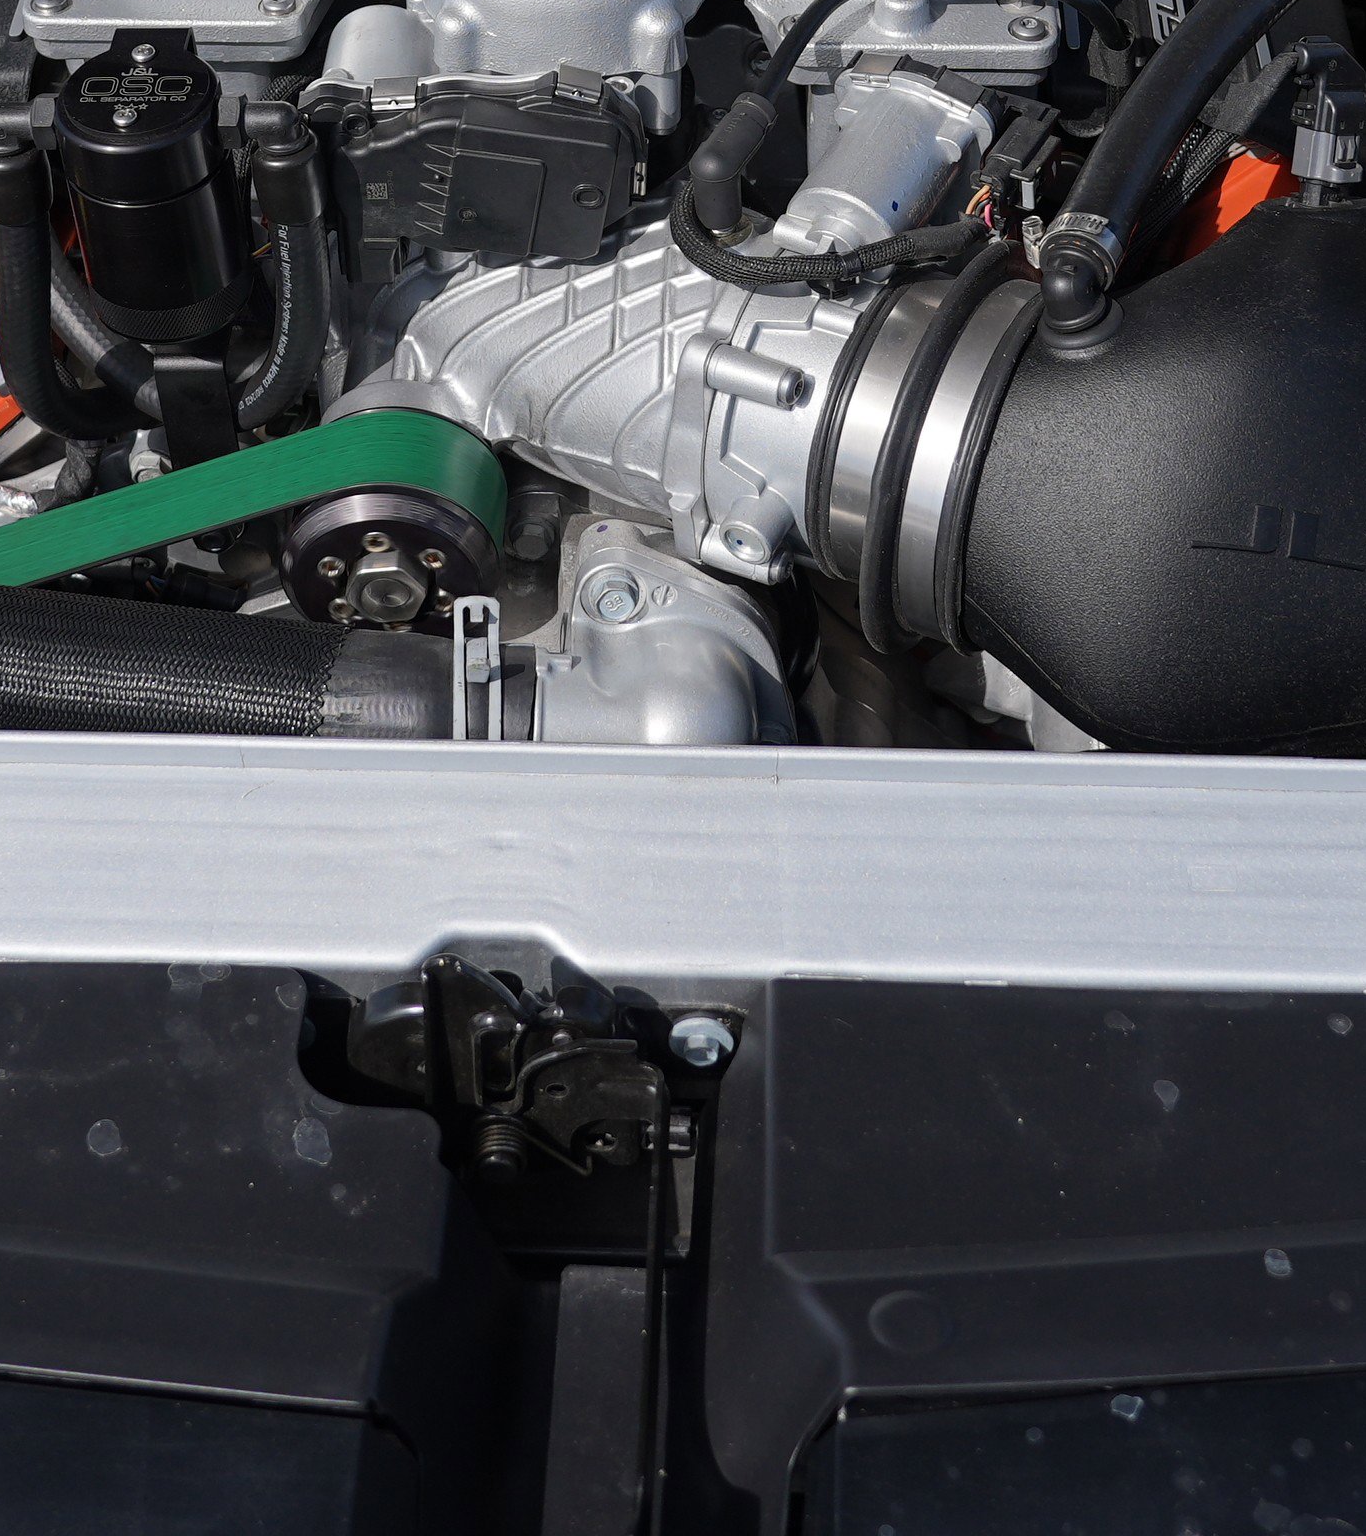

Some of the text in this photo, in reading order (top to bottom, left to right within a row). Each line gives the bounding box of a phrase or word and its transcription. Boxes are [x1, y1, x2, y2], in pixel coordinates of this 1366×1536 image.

[121, 67, 159, 76] J&L
[81, 76, 192, 96] OSC
[277, 224, 289, 241] For
[279, 240, 292, 262] Fuel
[280, 261, 293, 298] Injection
[281, 298, 293, 334] Systems
[276, 333, 289, 357] Made
[274, 354, 284, 365] in
